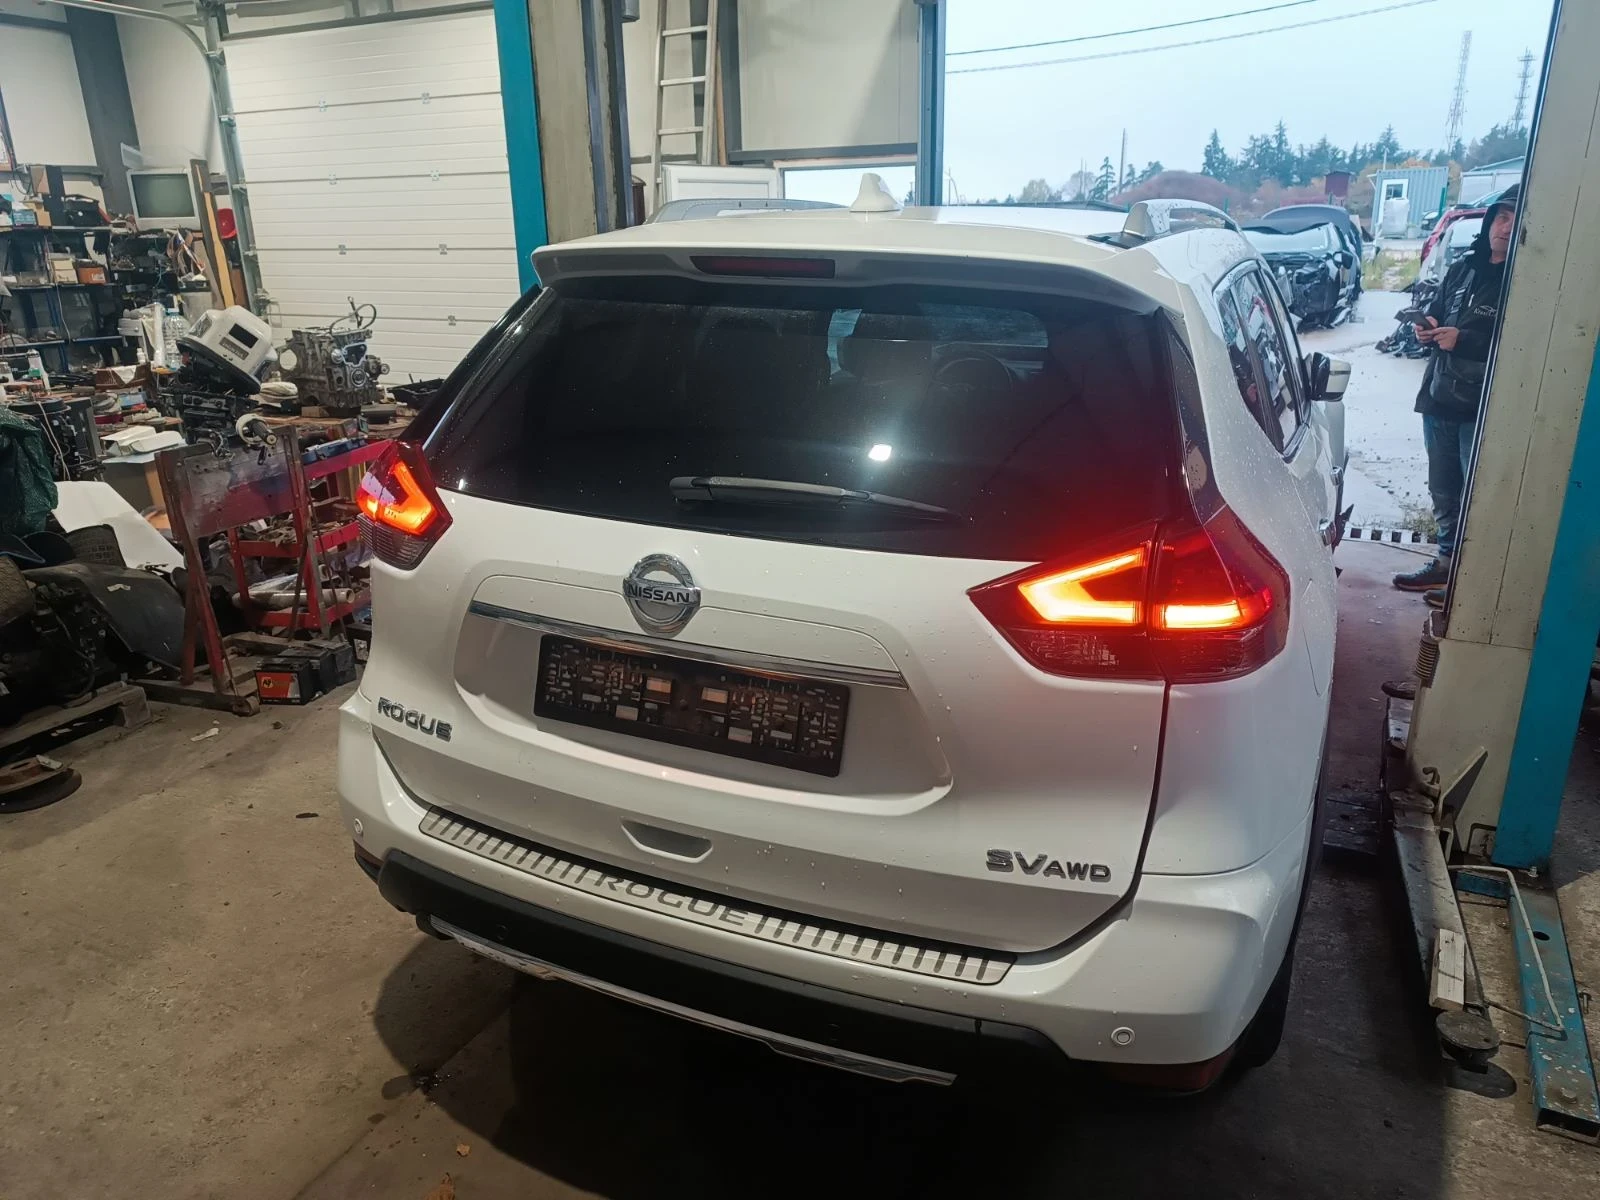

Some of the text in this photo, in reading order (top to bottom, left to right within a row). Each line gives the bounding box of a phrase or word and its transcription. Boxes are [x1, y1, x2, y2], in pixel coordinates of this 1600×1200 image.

[627, 584, 690, 603] NISSAN
[378, 697, 452, 742] ROGUE
[594, 872, 749, 927] ROGUE
